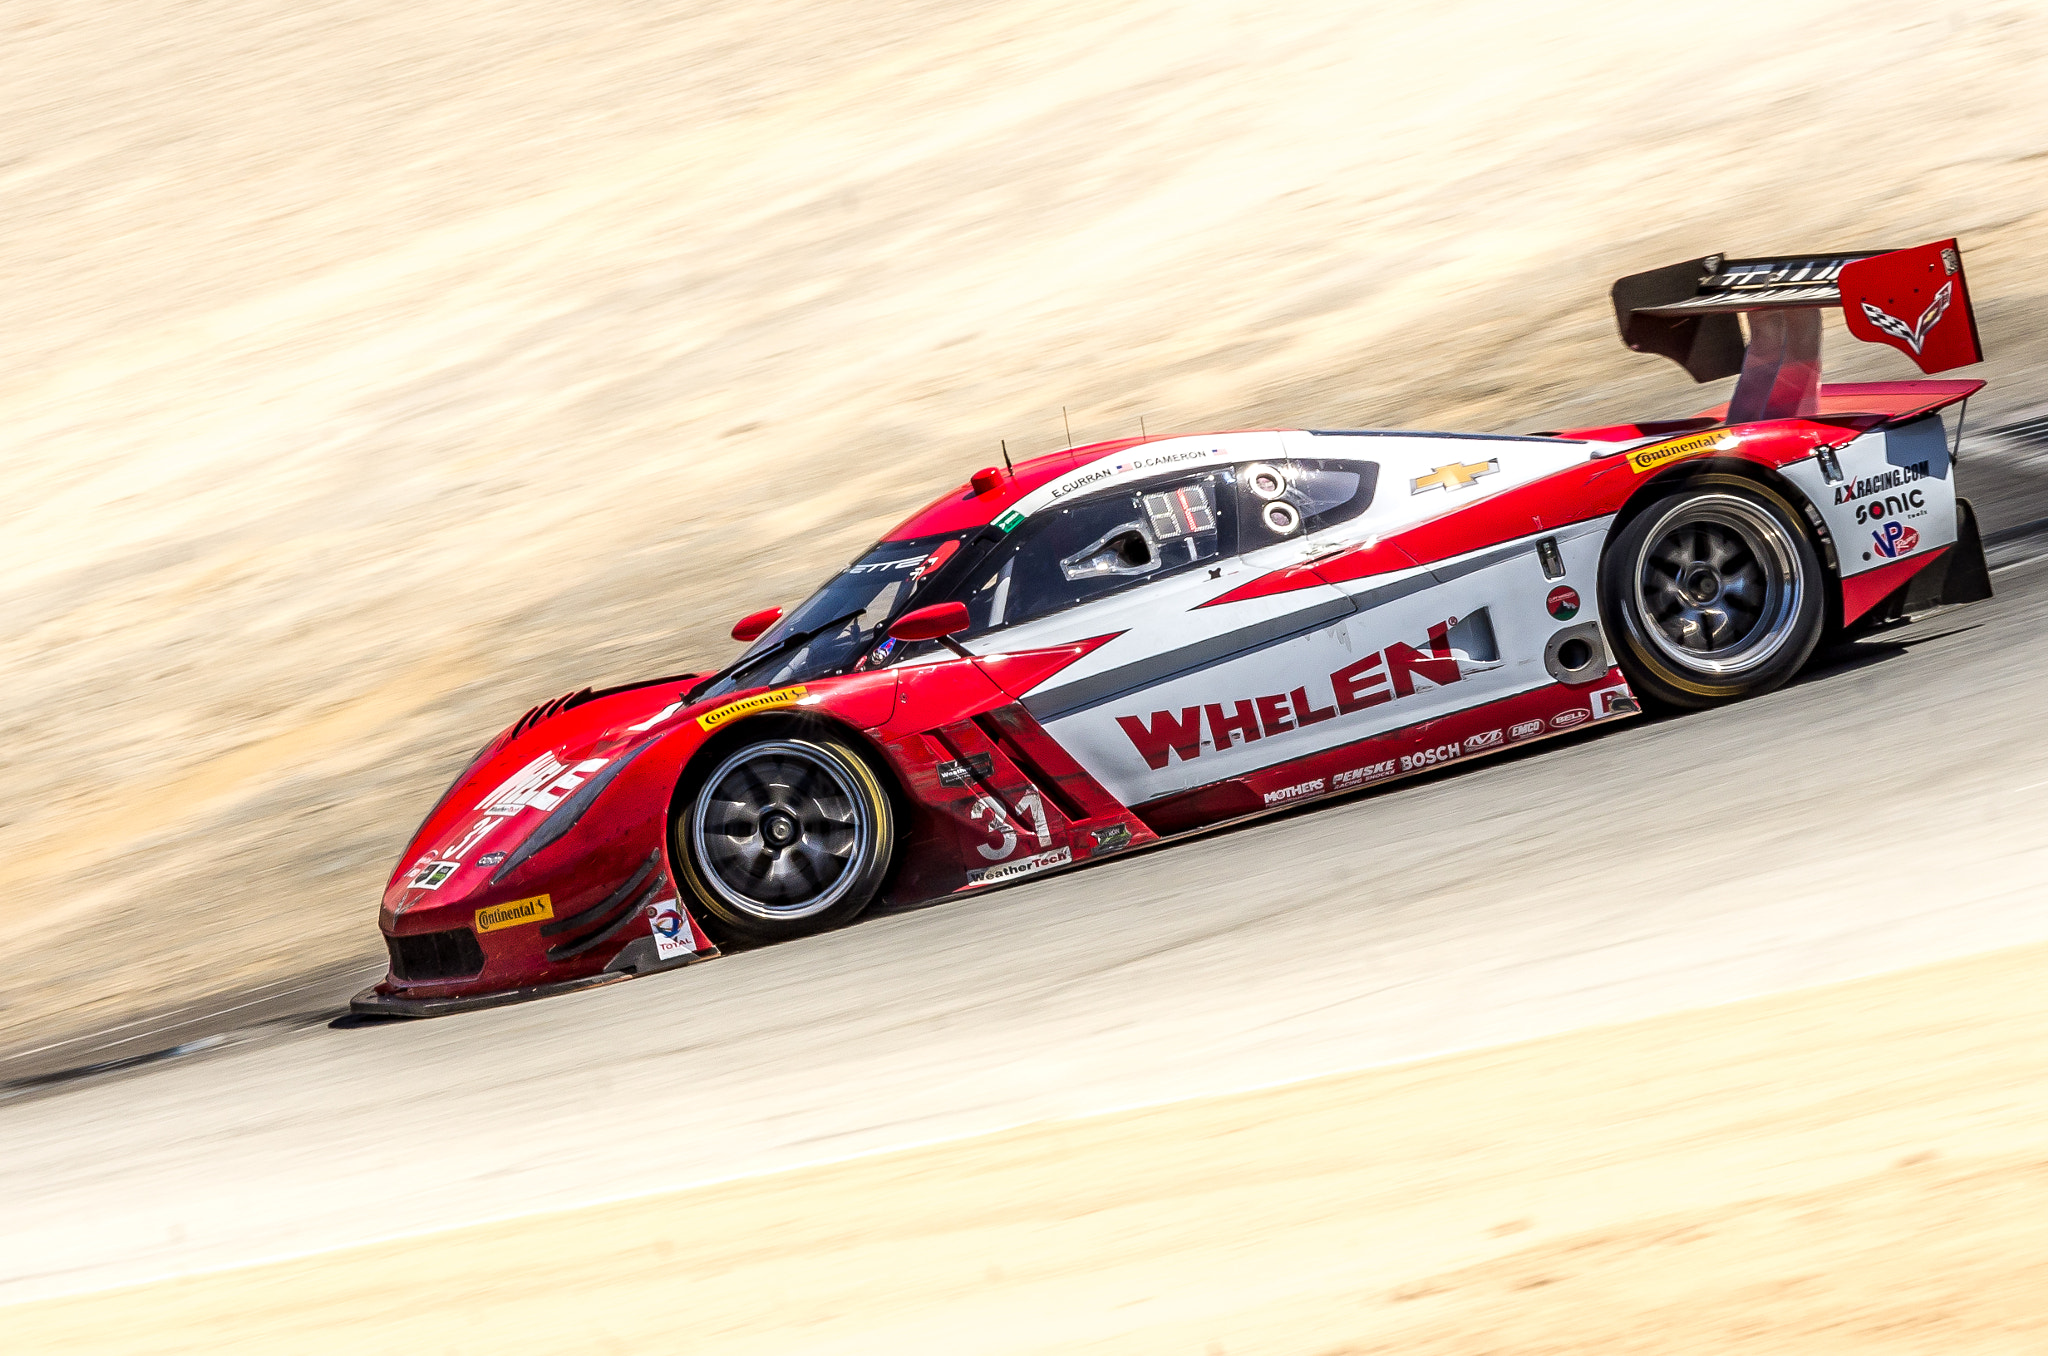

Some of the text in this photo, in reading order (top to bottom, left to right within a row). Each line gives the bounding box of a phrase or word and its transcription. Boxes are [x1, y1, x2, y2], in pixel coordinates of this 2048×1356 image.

[1635, 435, 1717, 468] Continental
[1051, 450, 1207, 498] E.CURRAN D.CAMERON
[1834, 460, 1930, 506] AXRACING.COM
[704, 690, 789, 725] Continental
[1115, 620, 1462, 771] WHELEN
[1512, 721, 1540, 737] EMCO
[1555, 710, 1586, 724] BELL
[1400, 742, 1461, 771] BOSCH
[1332, 759, 1396, 785] PENSKE
[1263, 778, 1325, 803] MOTHERS
[971, 784, 1052, 860] 31
[971, 851, 1068, 883] WeatherTech
[478, 901, 536, 930] Continental
[660, 937, 693, 951] TOTAL
